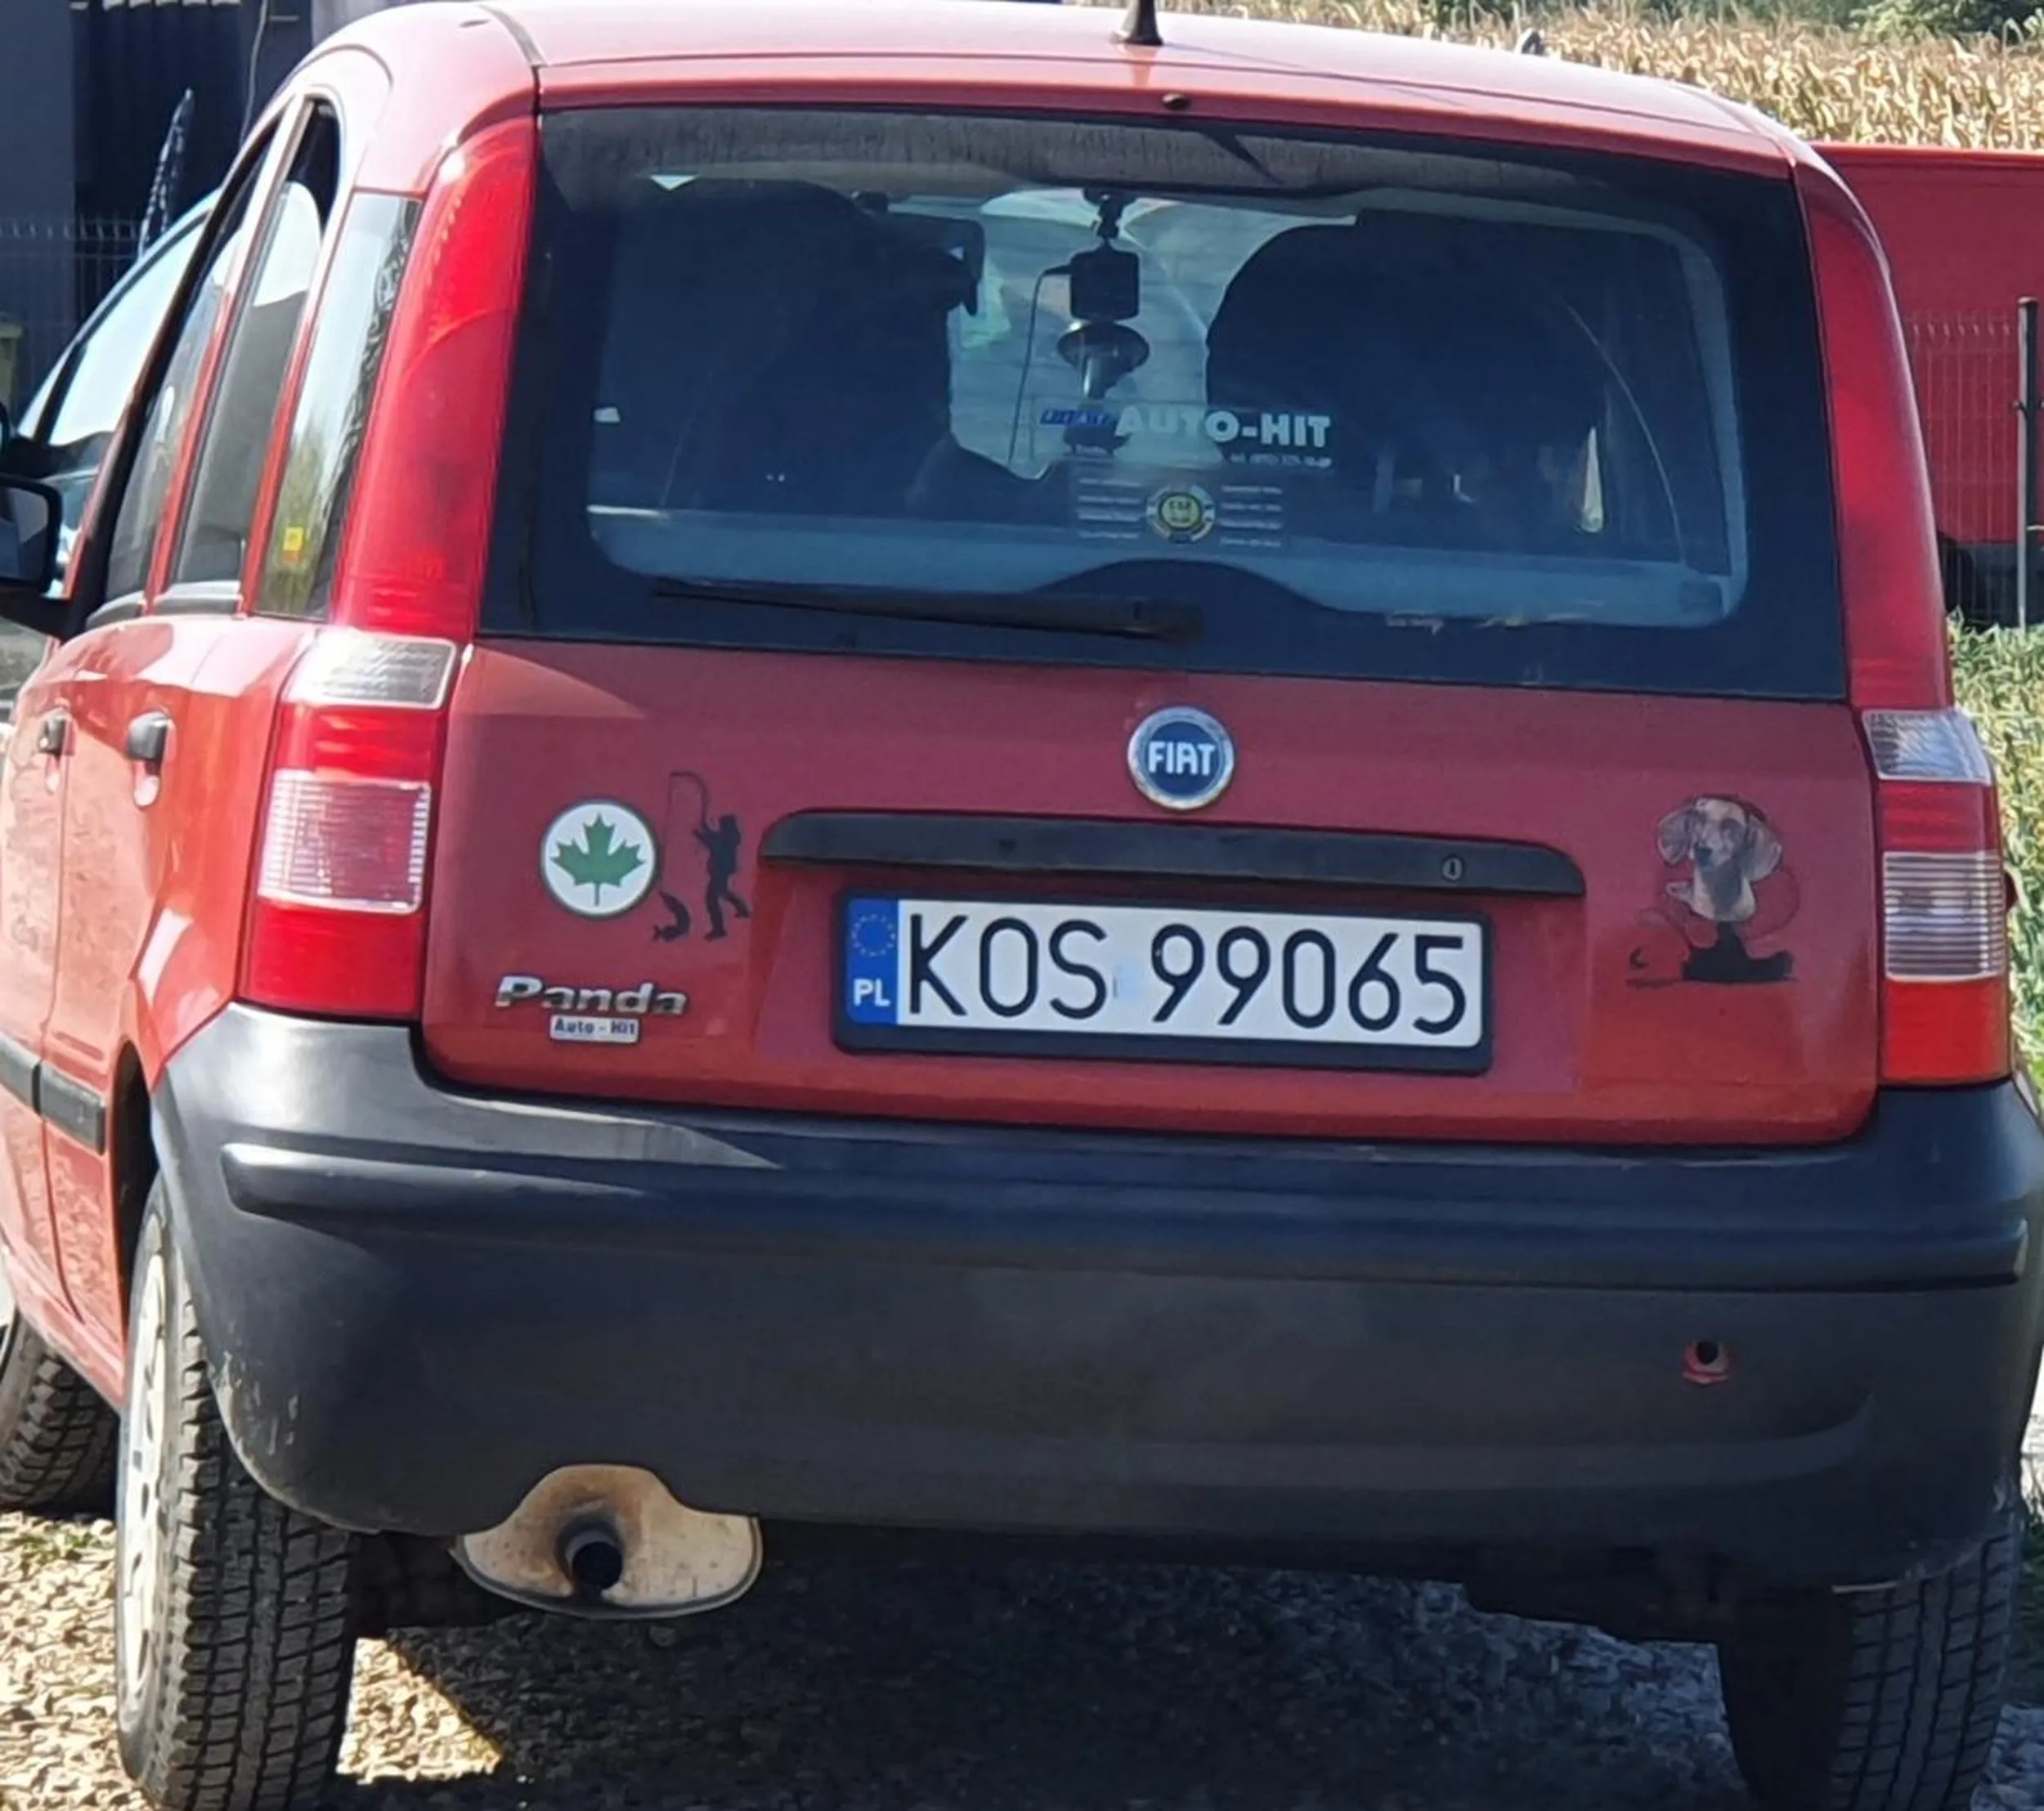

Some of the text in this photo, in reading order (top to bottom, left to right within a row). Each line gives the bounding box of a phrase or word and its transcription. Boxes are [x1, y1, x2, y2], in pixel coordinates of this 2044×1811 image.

[1114, 406, 1331, 448] AUTO-HIT
[1147, 741, 1216, 777] FIAT
[854, 979, 890, 1007] PL
[909, 913, 1467, 1036] KOS 99065
[495, 975, 688, 1015] Panda
[554, 1018, 595, 1034] Auto
